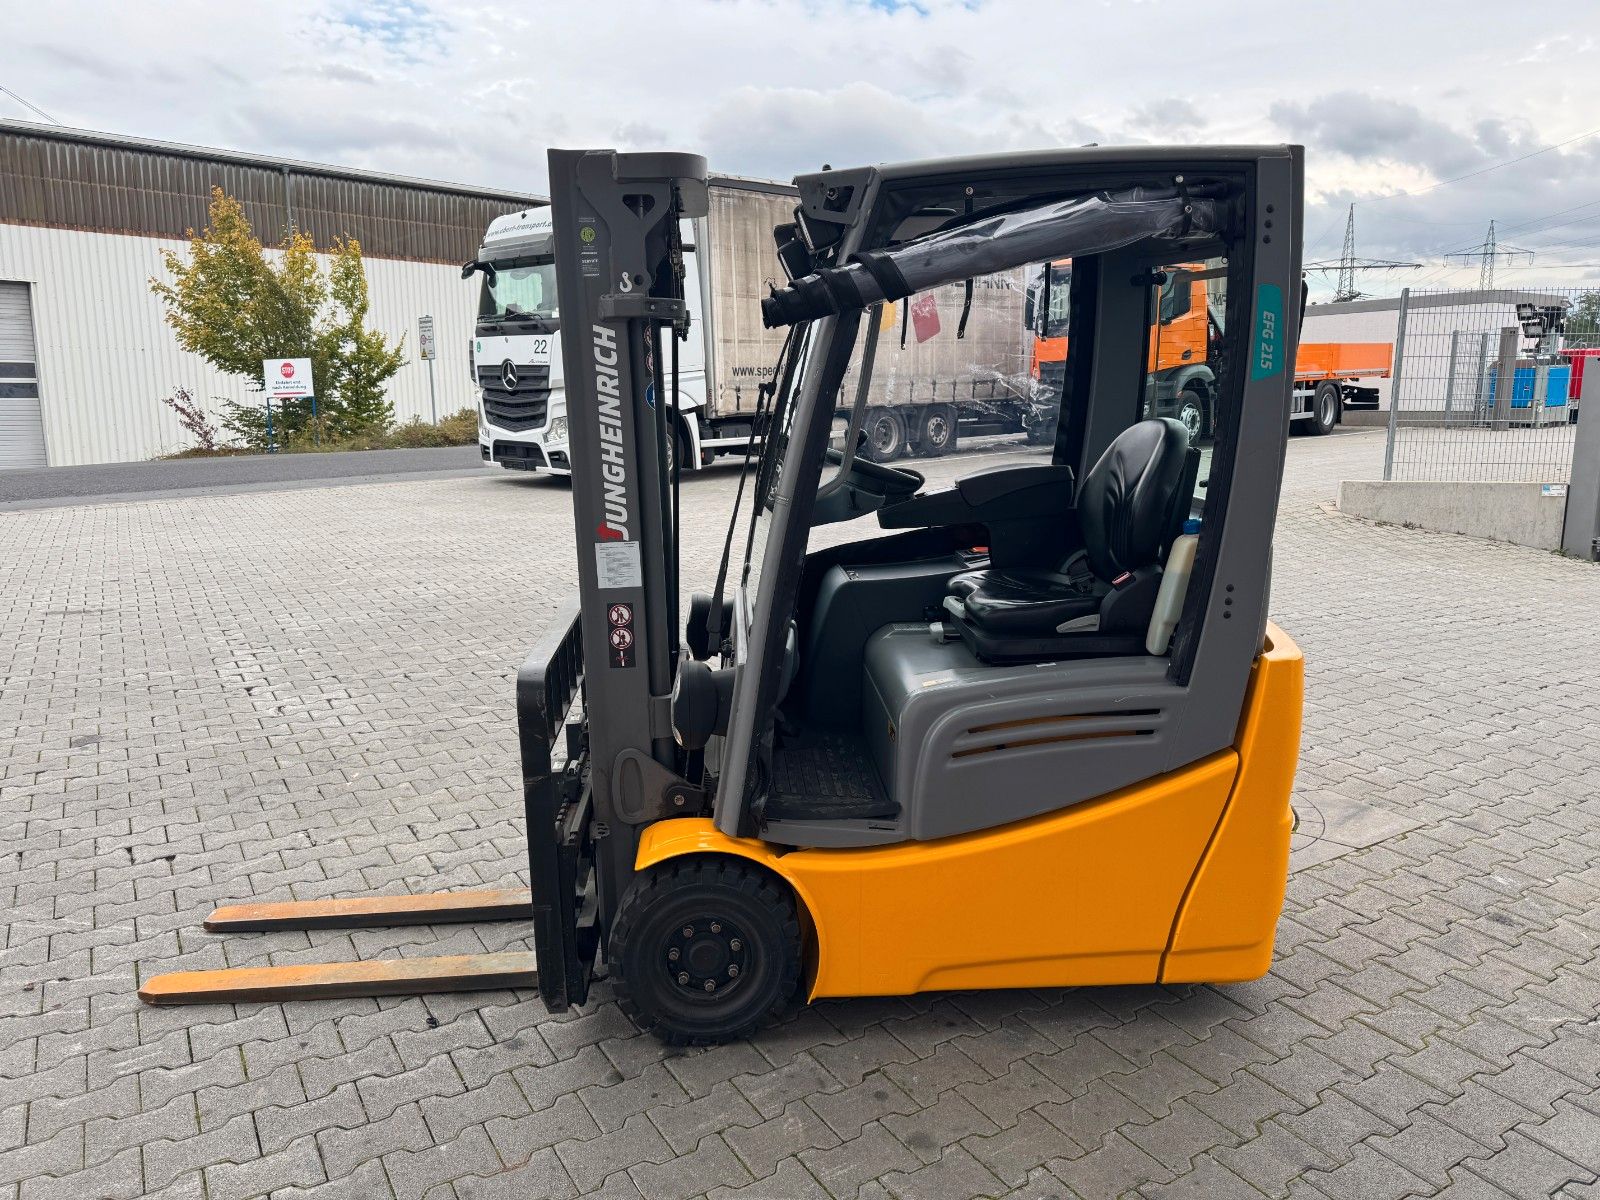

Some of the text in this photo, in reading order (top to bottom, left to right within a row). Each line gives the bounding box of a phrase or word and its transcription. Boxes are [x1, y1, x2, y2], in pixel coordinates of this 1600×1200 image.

[534, 339, 548, 354] 22
[1261, 311, 1275, 369] EFG 215
[281, 366, 294, 374] STOP
[593, 325, 629, 541] JUNGHEINRICH
